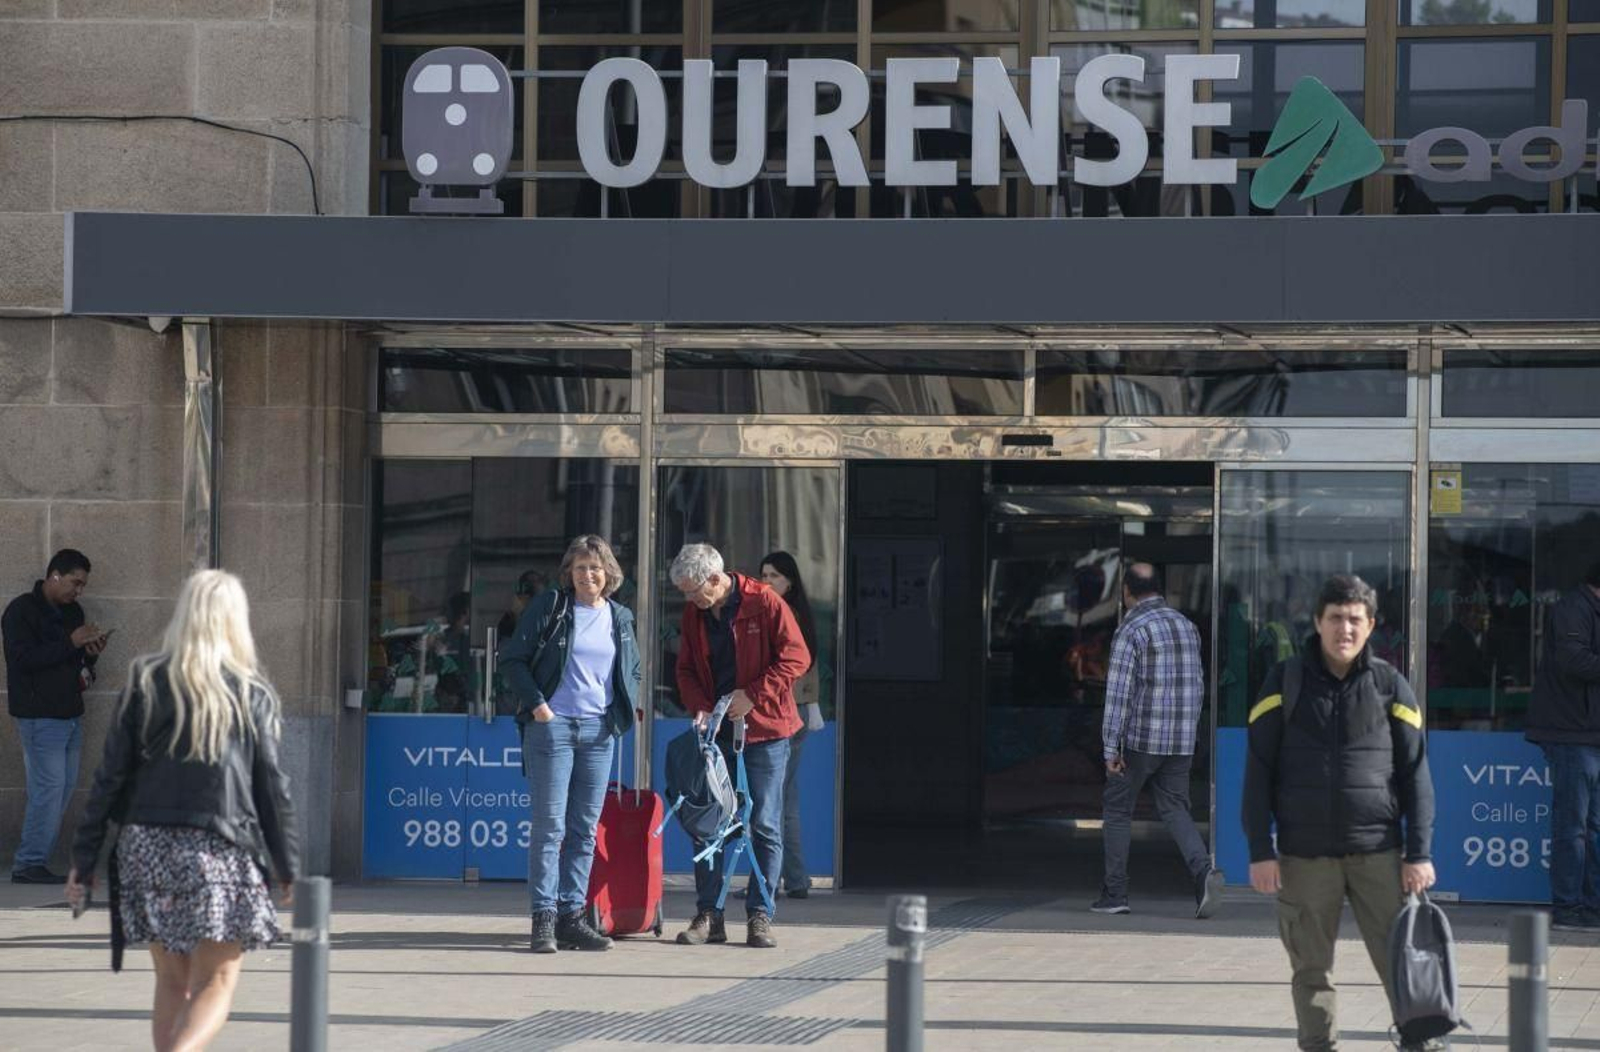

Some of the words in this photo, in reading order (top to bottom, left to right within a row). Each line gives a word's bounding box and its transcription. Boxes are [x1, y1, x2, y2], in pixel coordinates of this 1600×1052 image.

[576, 54, 1241, 188] OURENSE
[1404, 99, 1600, 182] ad
[388, 787, 442, 807] Calle
[449, 787, 531, 807] Vicente
[1471, 802, 1528, 823] Calle
[404, 820, 461, 847] 988
[470, 820, 508, 847] 03
[1463, 836, 1530, 868] 988
